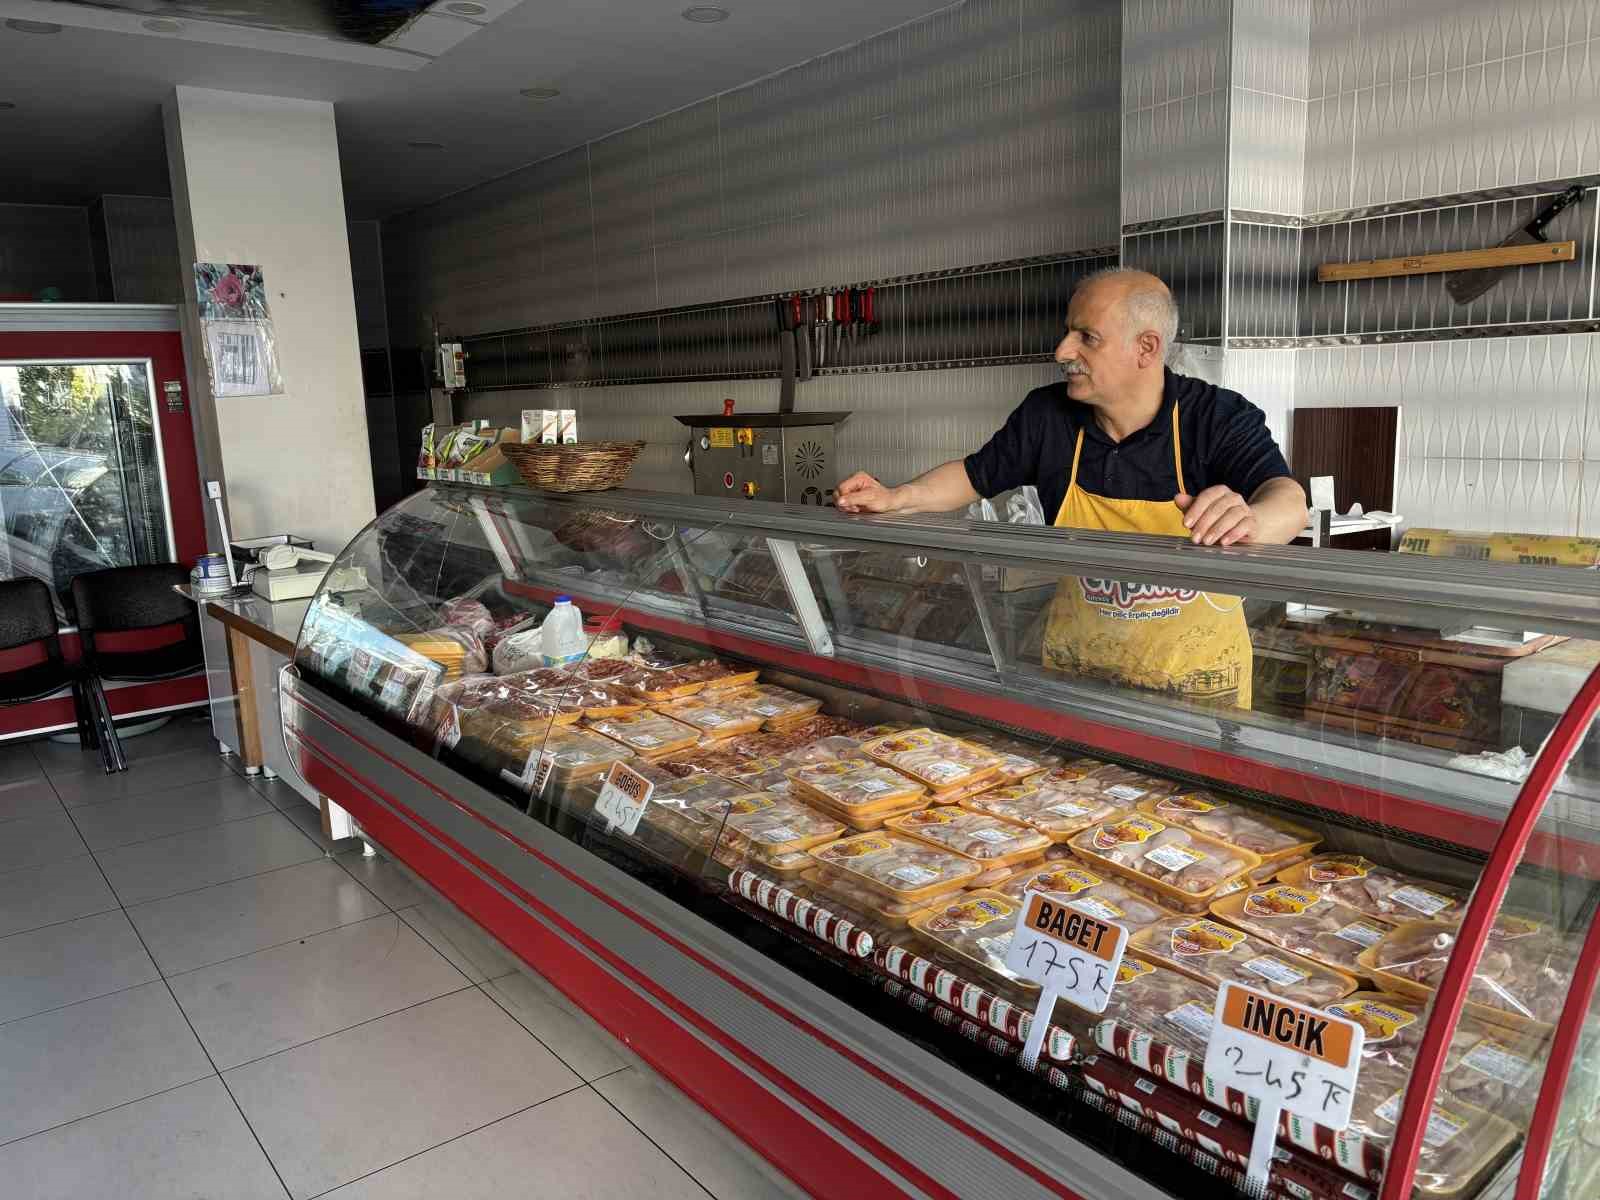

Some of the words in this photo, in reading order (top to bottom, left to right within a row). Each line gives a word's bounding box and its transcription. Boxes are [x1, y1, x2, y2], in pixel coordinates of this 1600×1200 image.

[1151, 607, 1180, 617] değildir
[1036, 901, 1108, 953] BAGET
[1024, 940, 1085, 990] 175
